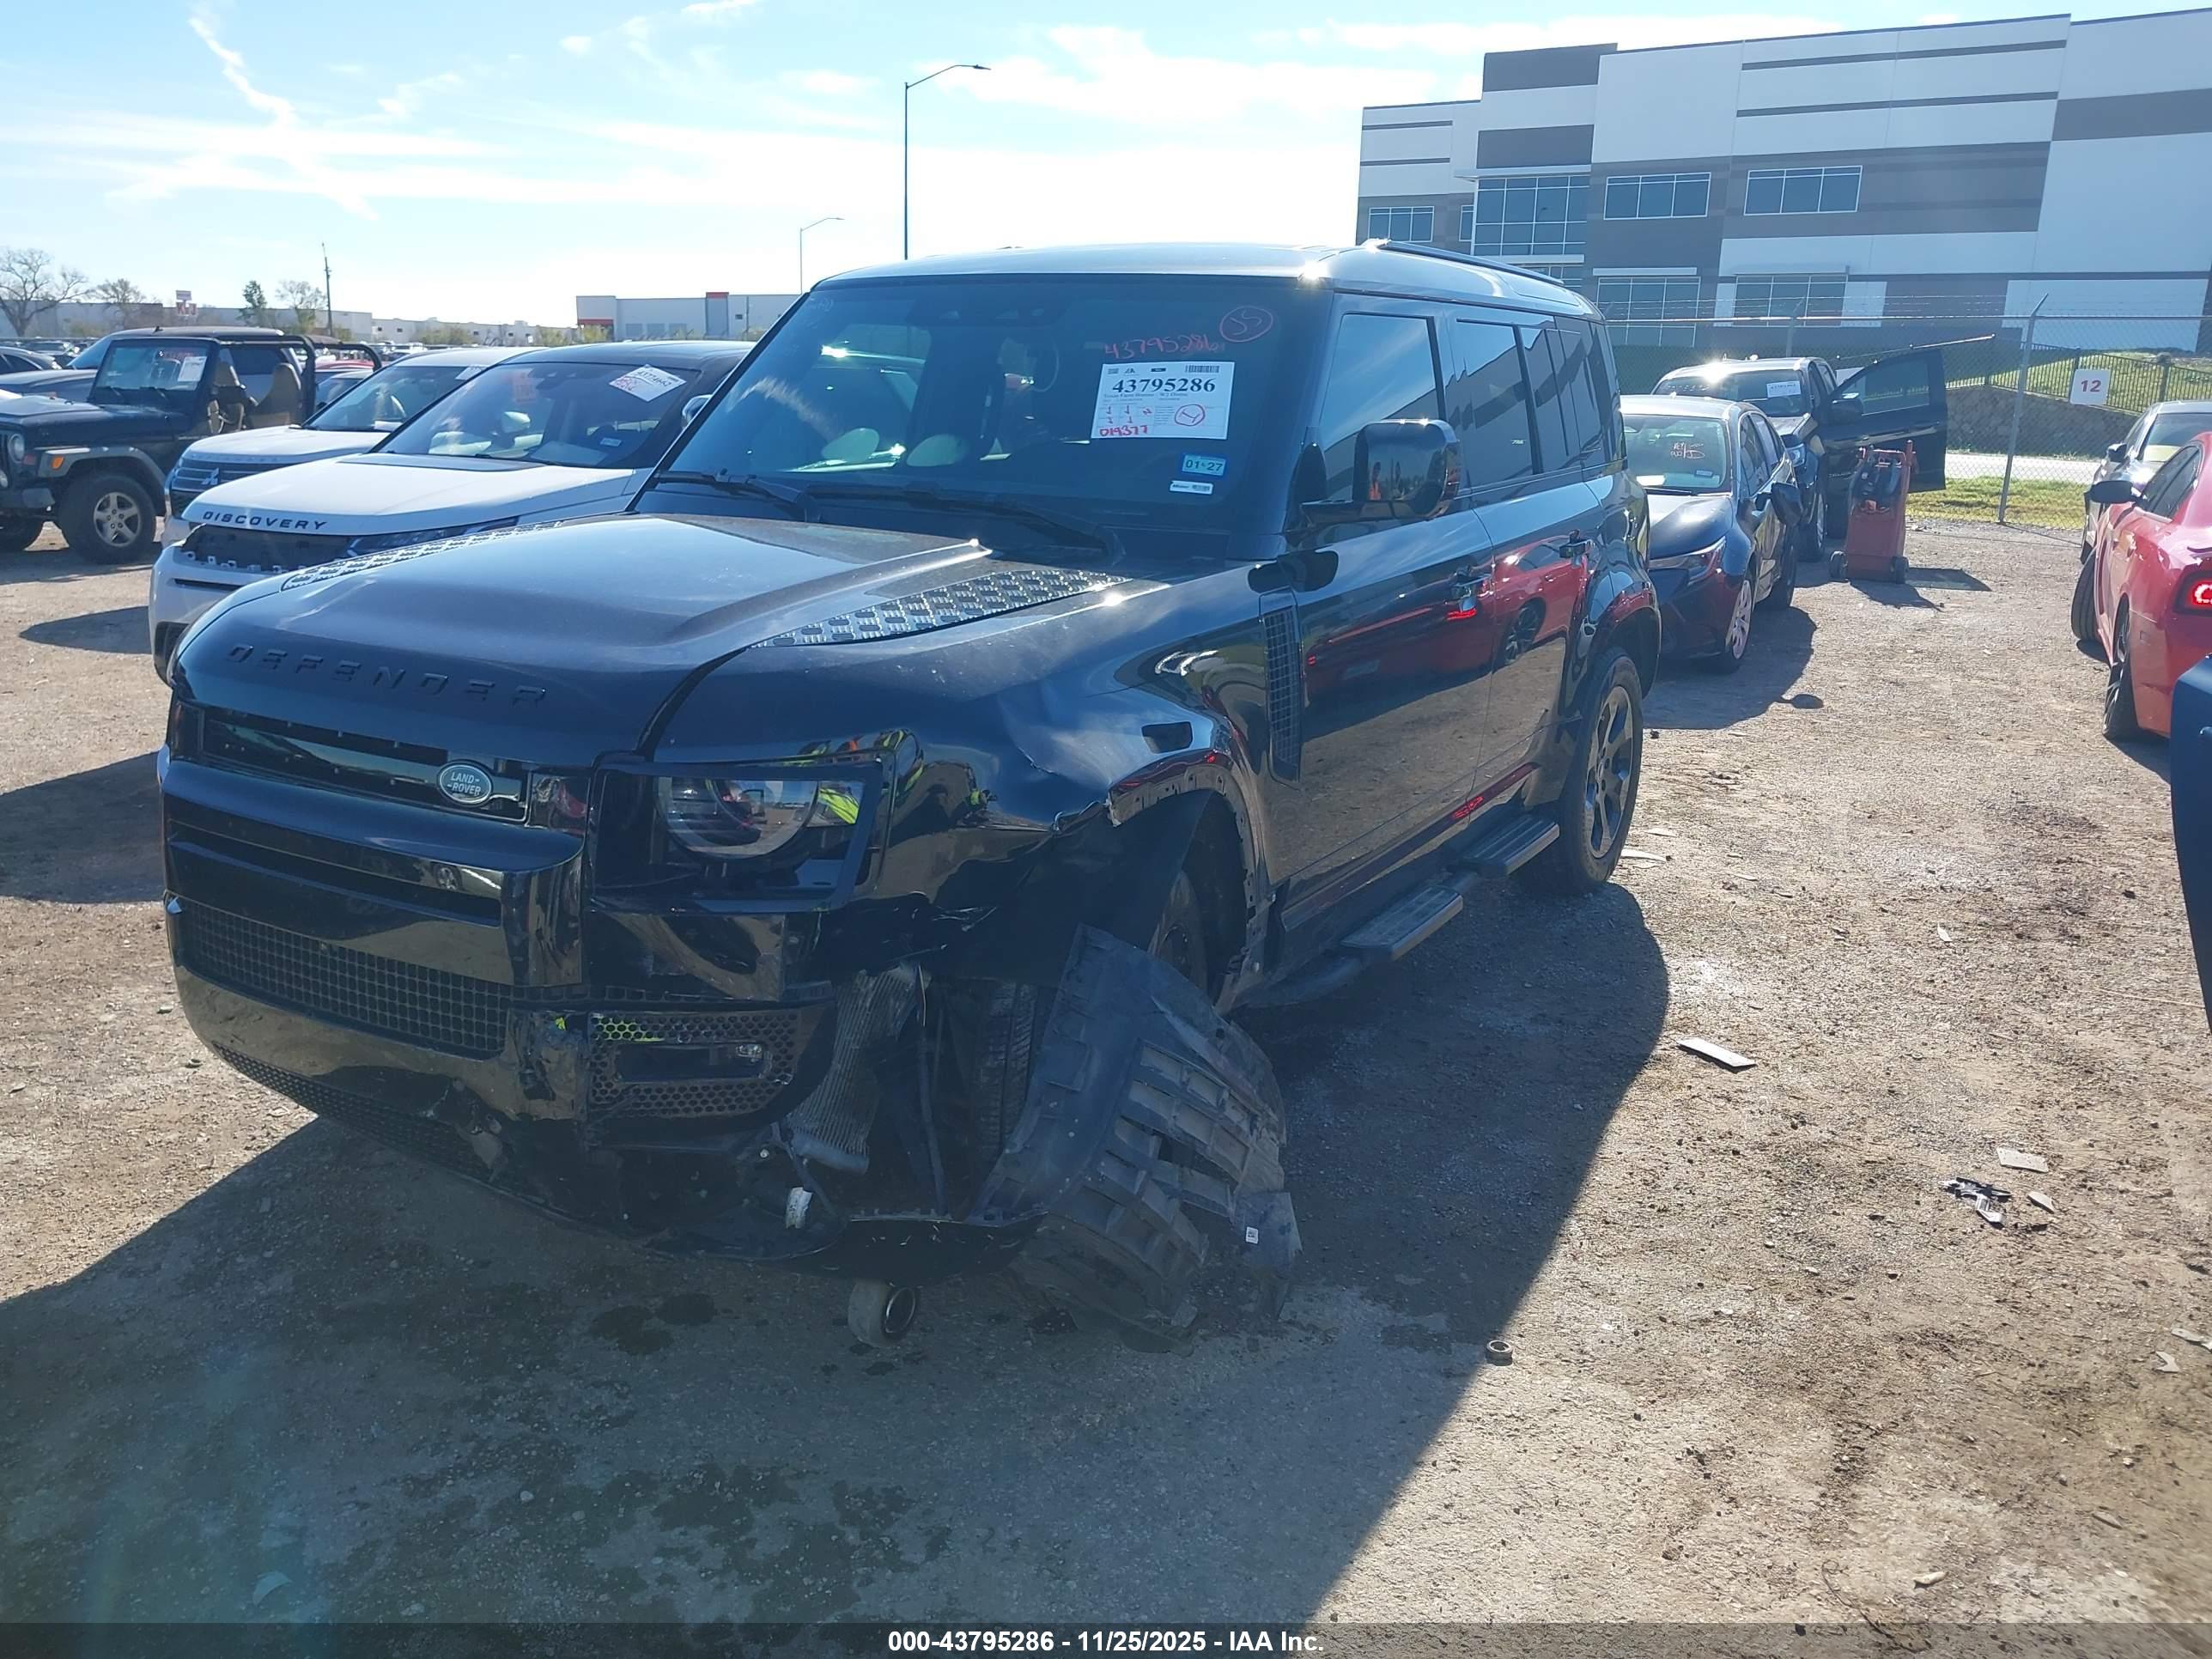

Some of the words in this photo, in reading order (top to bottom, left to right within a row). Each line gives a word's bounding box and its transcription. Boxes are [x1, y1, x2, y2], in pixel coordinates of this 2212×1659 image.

[1112, 378, 1217, 393] 43795286
[2081, 380, 2102, 392] 12
[203, 511, 327, 530] DISCOVERY
[224, 643, 548, 708] DEFENDER
